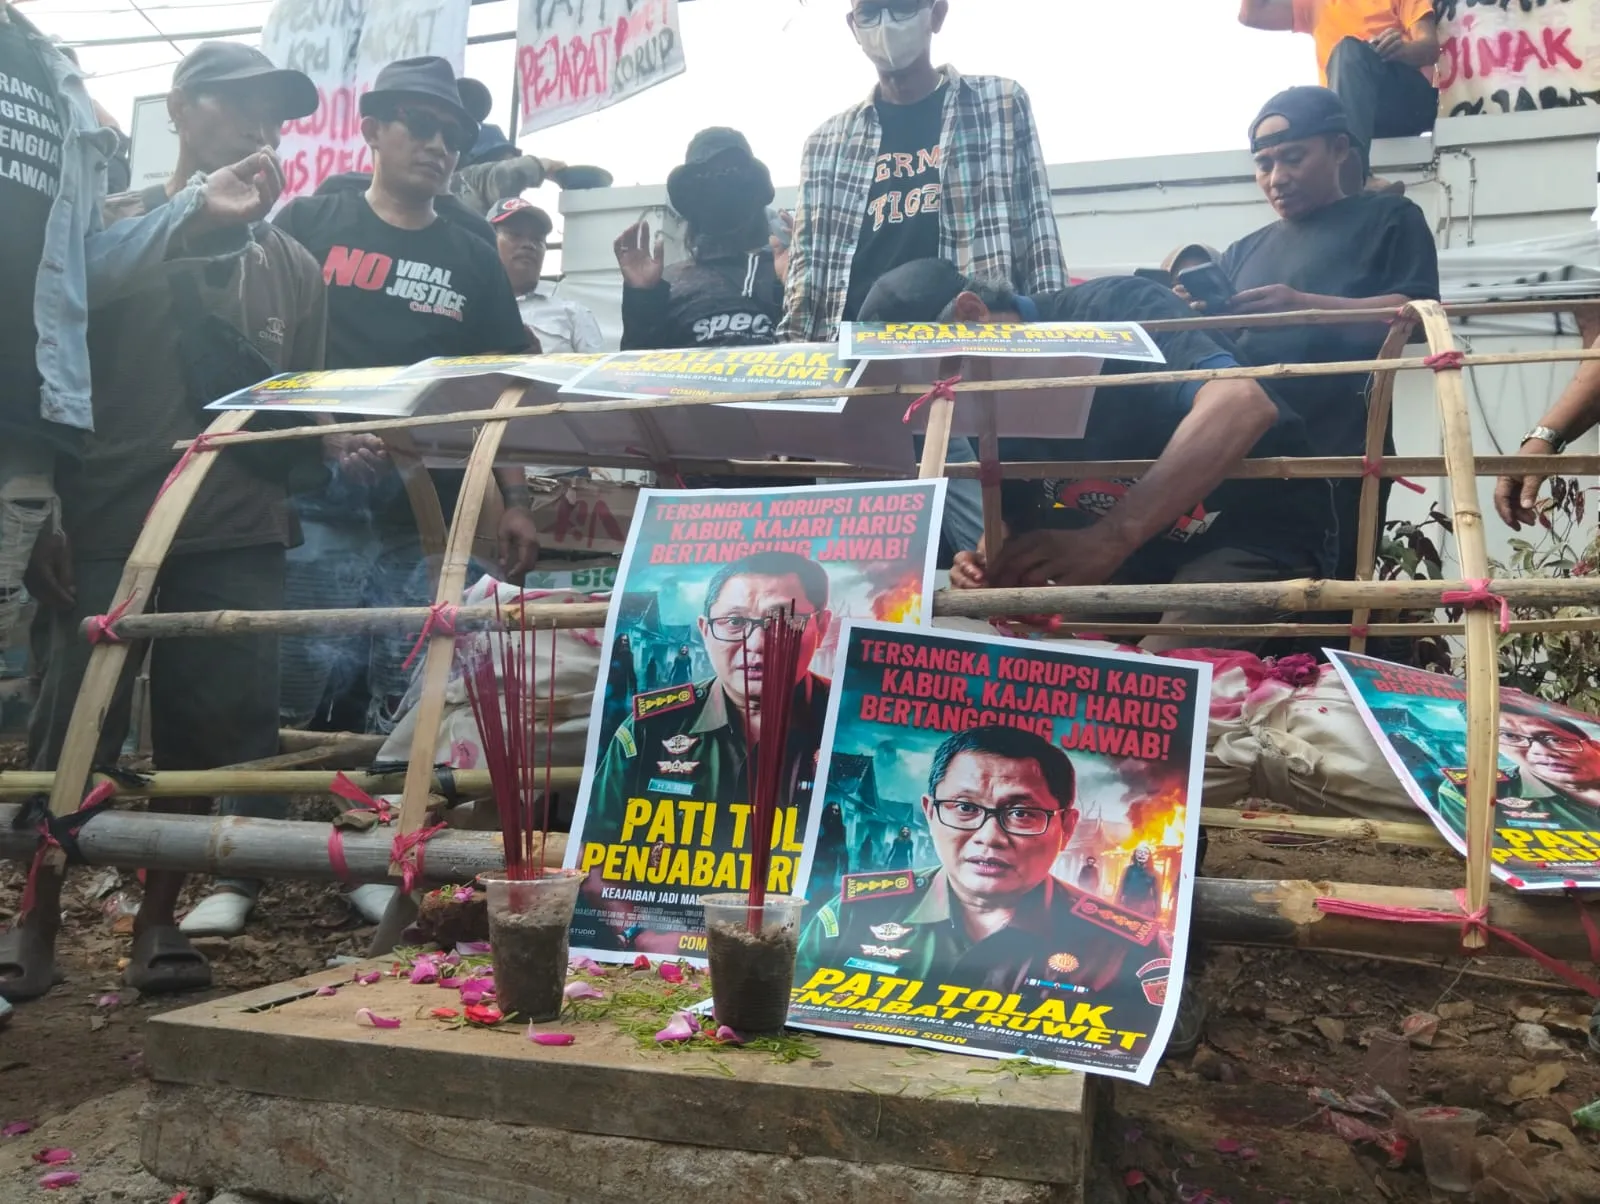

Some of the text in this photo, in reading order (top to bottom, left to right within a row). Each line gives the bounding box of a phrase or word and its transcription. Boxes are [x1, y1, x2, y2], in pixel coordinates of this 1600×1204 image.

[322, 245, 393, 291] NO
[396, 258, 452, 288] VIRAL
[386, 278, 467, 312] JUSTICE
[724, 351, 835, 367] TOLAK
[747, 364, 852, 383] RUWET
[656, 494, 925, 521] TERSANGKA KORUPSI KADES
[754, 517, 832, 539] KAJARI
[839, 515, 917, 536] HARUS
[818, 538, 910, 562] JAWAB!
[861, 639, 1188, 701] TERSANGKA KORUPSI KADES
[882, 669, 1179, 730] KABUR, KAJARI HARUS
[1061, 722, 1171, 760] JAWAB!
[620, 798, 717, 847] PATI
[581, 842, 752, 889] PENJABAT
[602, 887, 656, 902] KEAJAIBAN
[657, 892, 679, 904] JADI
[678, 935, 708, 952] COM
[801, 967, 1113, 1029] PATI TOLAK
[853, 1023, 968, 1045] COMING SOON
[975, 1012, 1148, 1050] RUWET
[978, 1025, 1024, 1037] HARUS
[1026, 1033, 1103, 1050] MEMBAYAR
